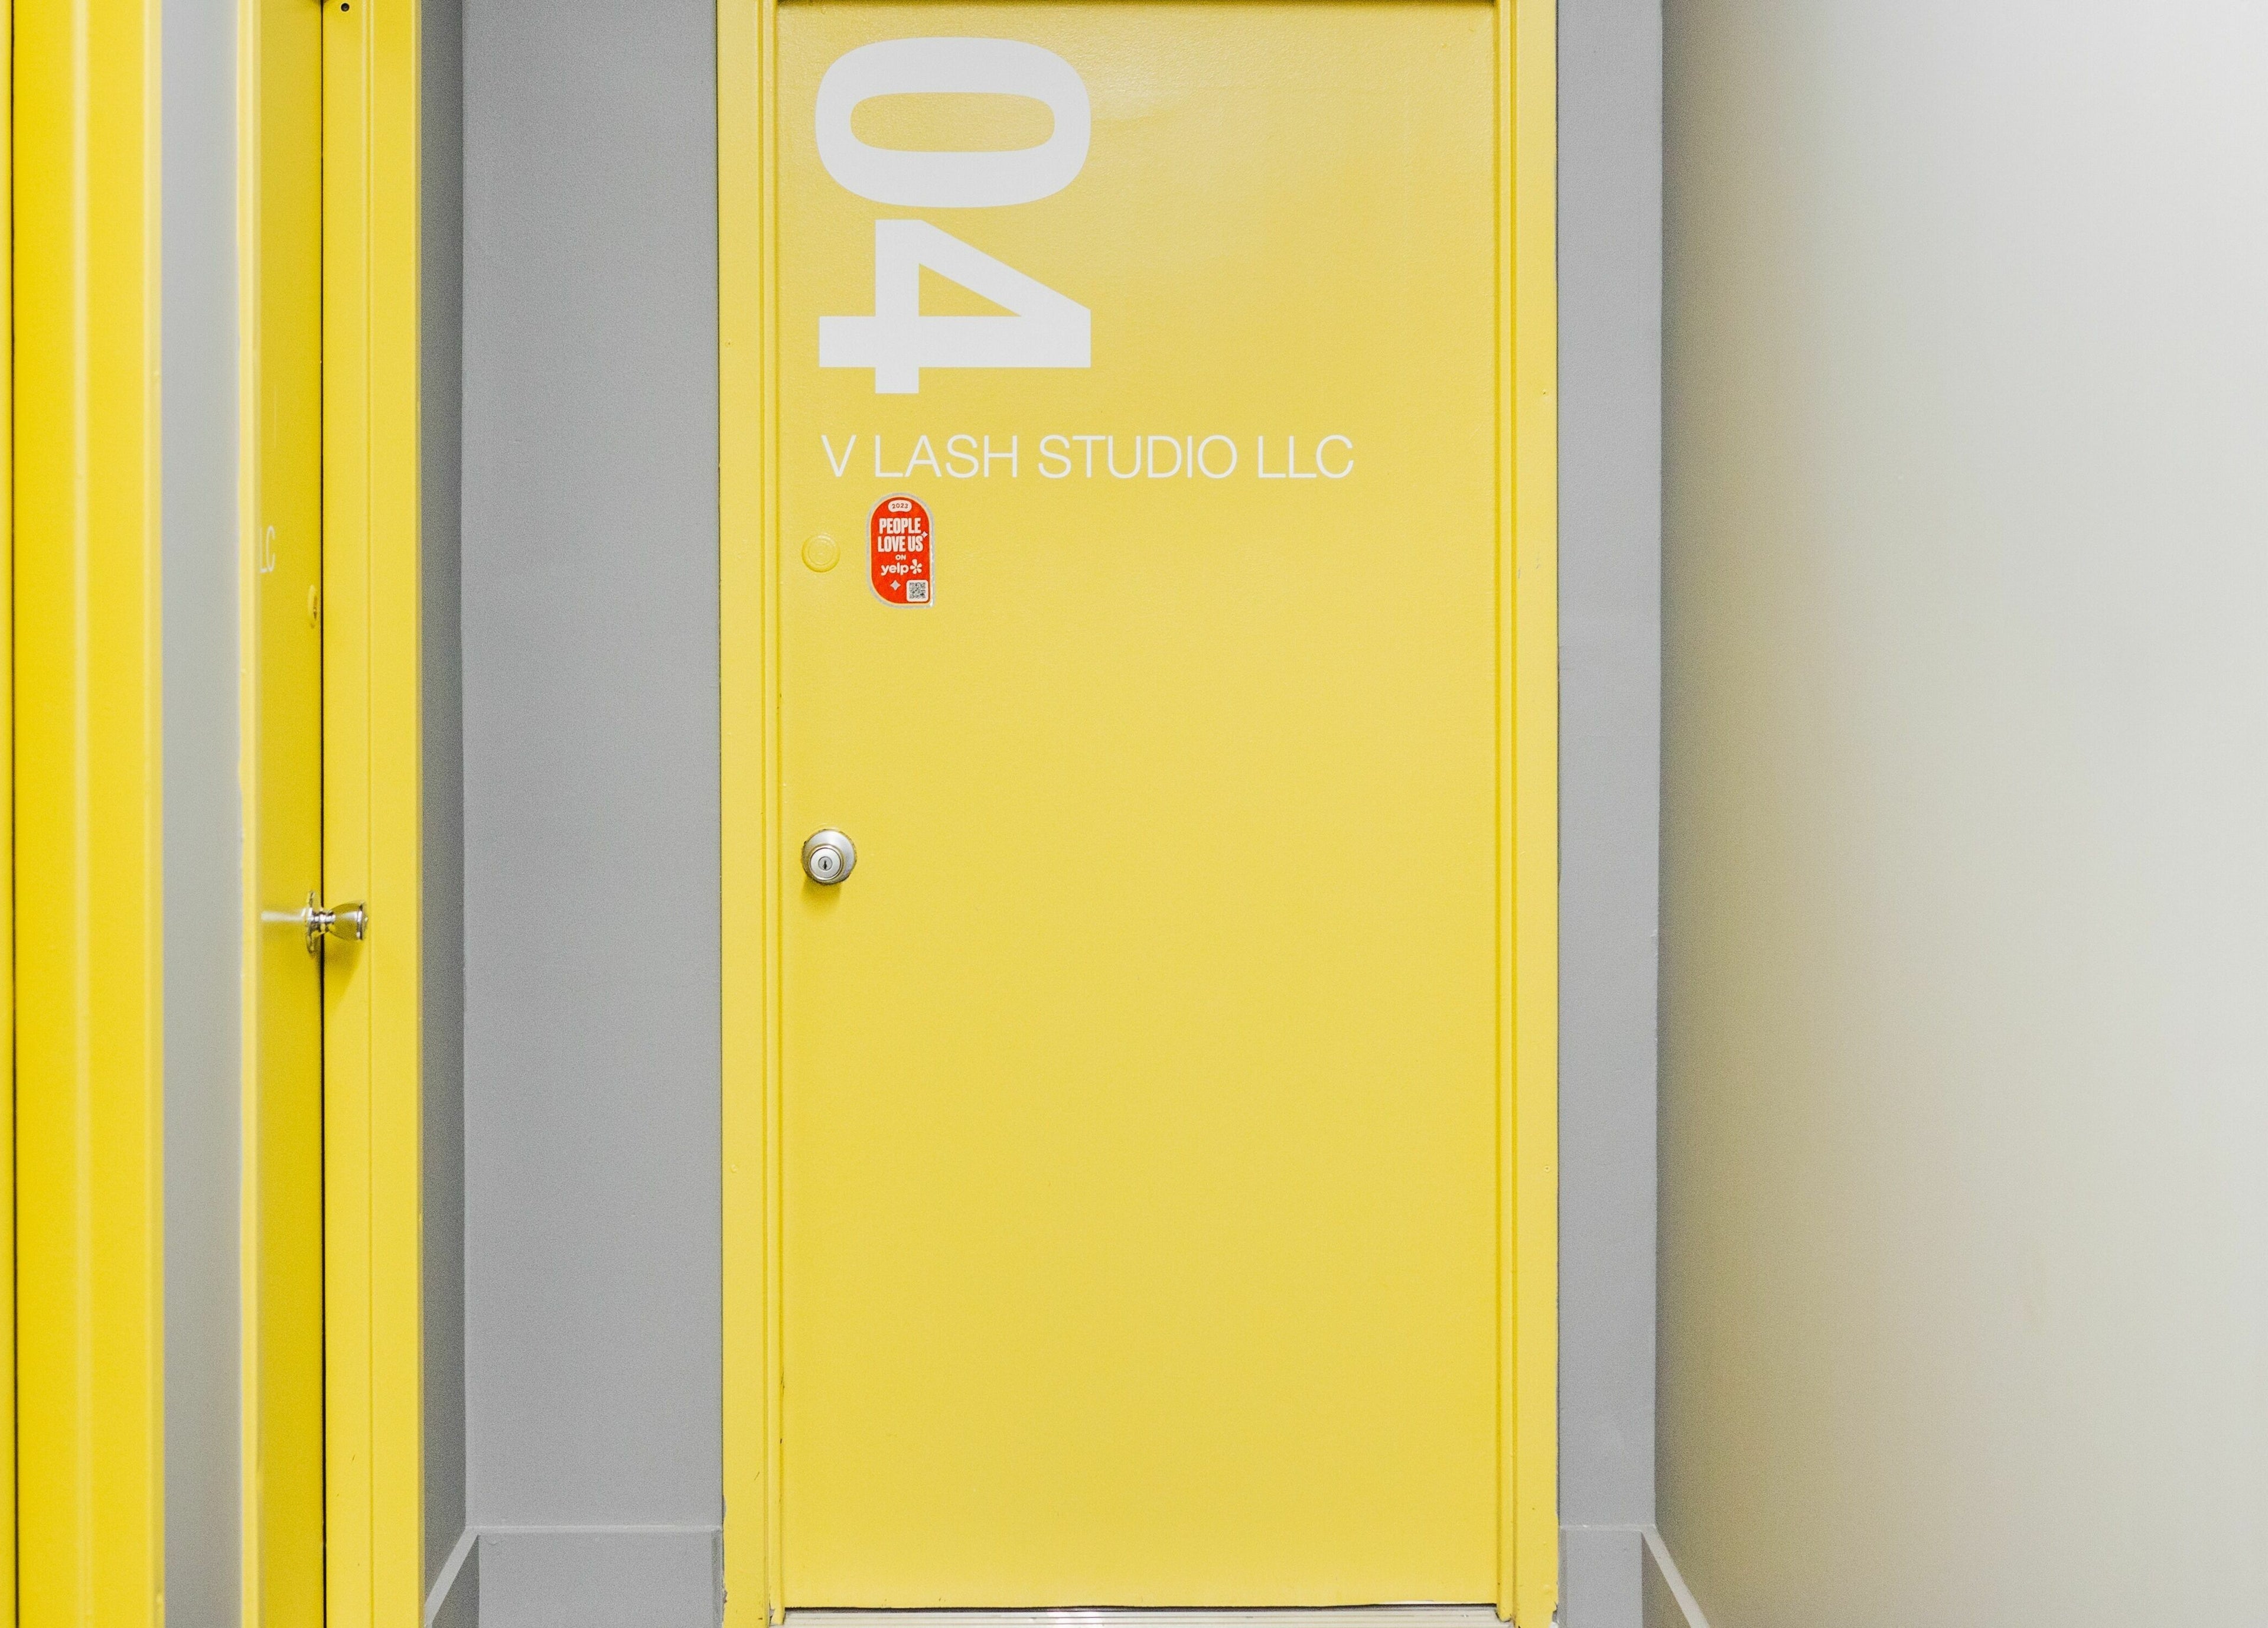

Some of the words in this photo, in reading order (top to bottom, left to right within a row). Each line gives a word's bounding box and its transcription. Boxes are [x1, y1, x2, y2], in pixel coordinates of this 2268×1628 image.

[815, 37, 1091, 394] 04
[821, 435, 856, 477] V
[875, 434, 1017, 478] LASH
[1038, 434, 1237, 478] STUDIO
[1258, 434, 1354, 478] LLC
[879, 517, 921, 534] PEOPLE
[878, 536, 906, 552] LOVE
[907, 535, 923, 552] US
[881, 562, 909, 576] yelp
